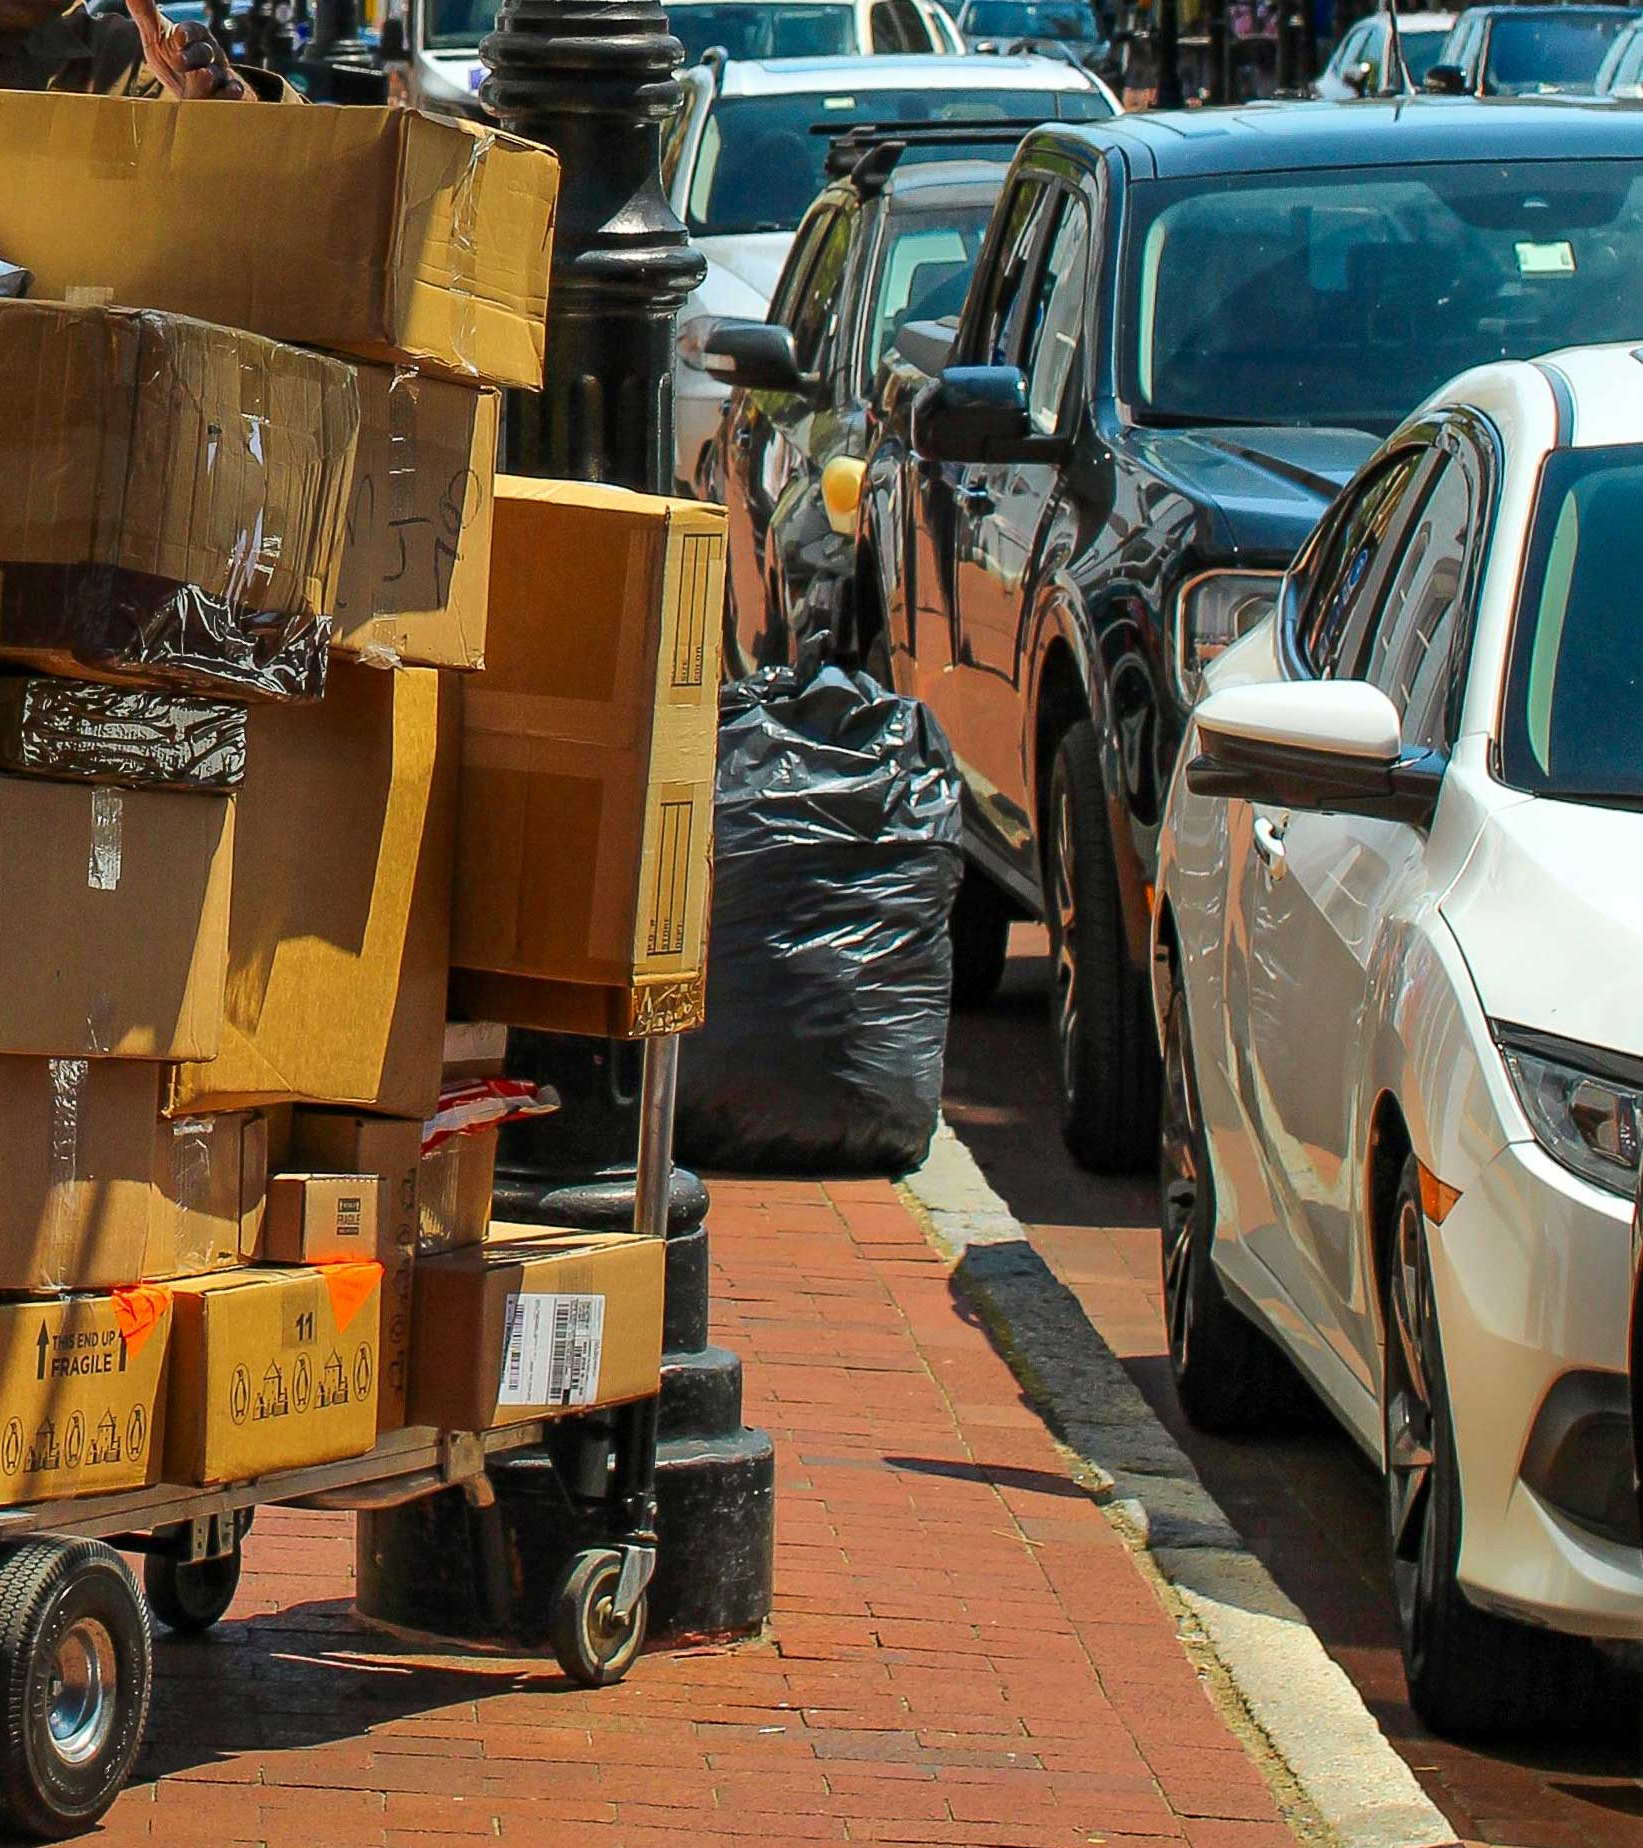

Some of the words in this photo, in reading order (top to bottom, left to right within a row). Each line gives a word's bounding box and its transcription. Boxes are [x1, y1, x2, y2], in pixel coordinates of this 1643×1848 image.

[295, 1311, 314, 1342] 11
[77, 1331, 99, 1349] END
[101, 1330, 116, 1346] UP
[51, 1353, 113, 1378] FRAGILE
